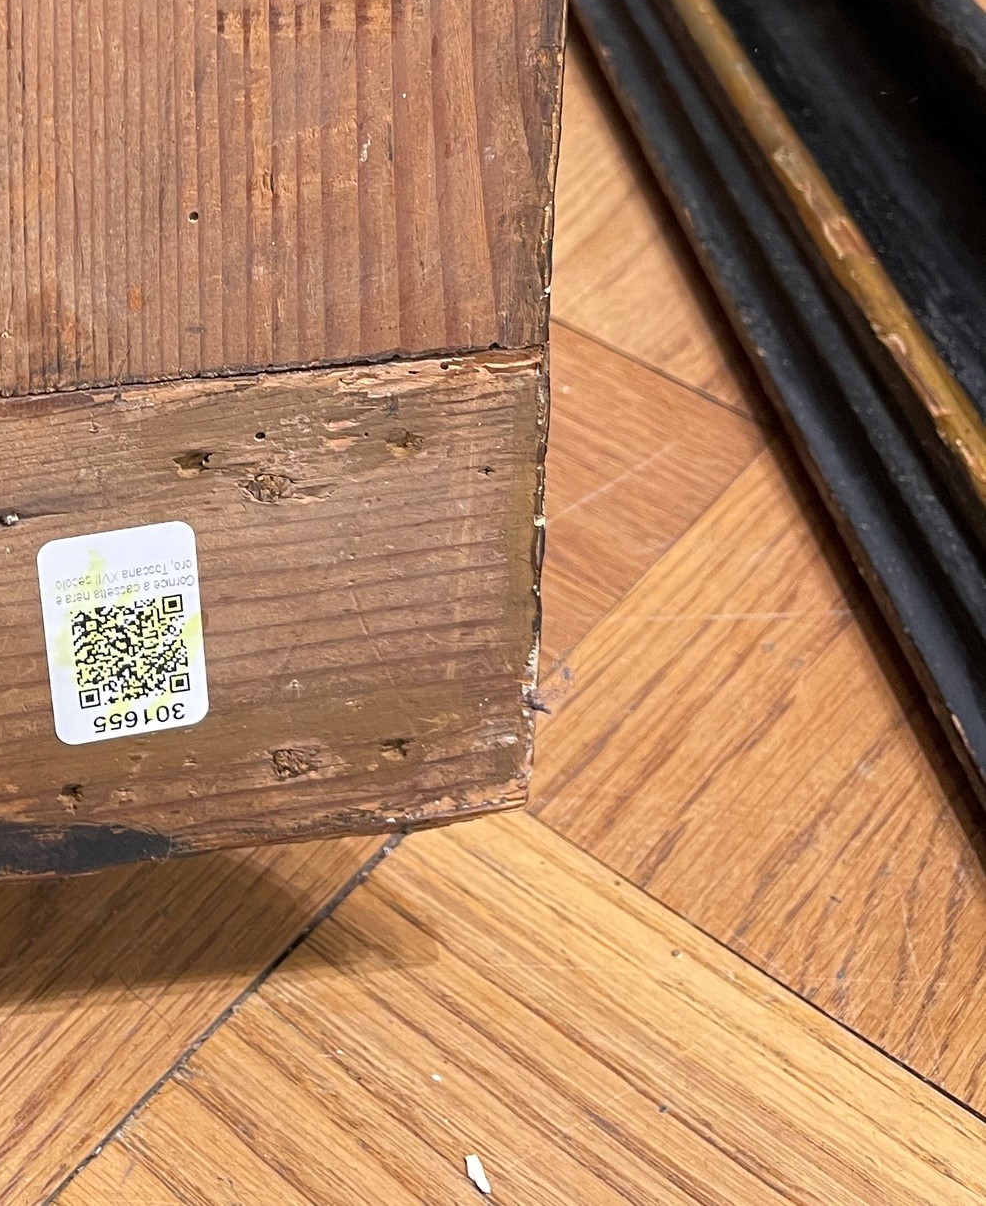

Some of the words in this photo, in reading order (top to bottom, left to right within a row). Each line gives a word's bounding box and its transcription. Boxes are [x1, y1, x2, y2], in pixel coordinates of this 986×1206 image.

[55, 576, 92, 590] secolo
[95, 571, 119, 585] XVII
[144, 582, 150, 590] a
[55, 597, 62, 605] e
[66, 592, 91, 604] nera
[93, 703, 185, 734] 301655
